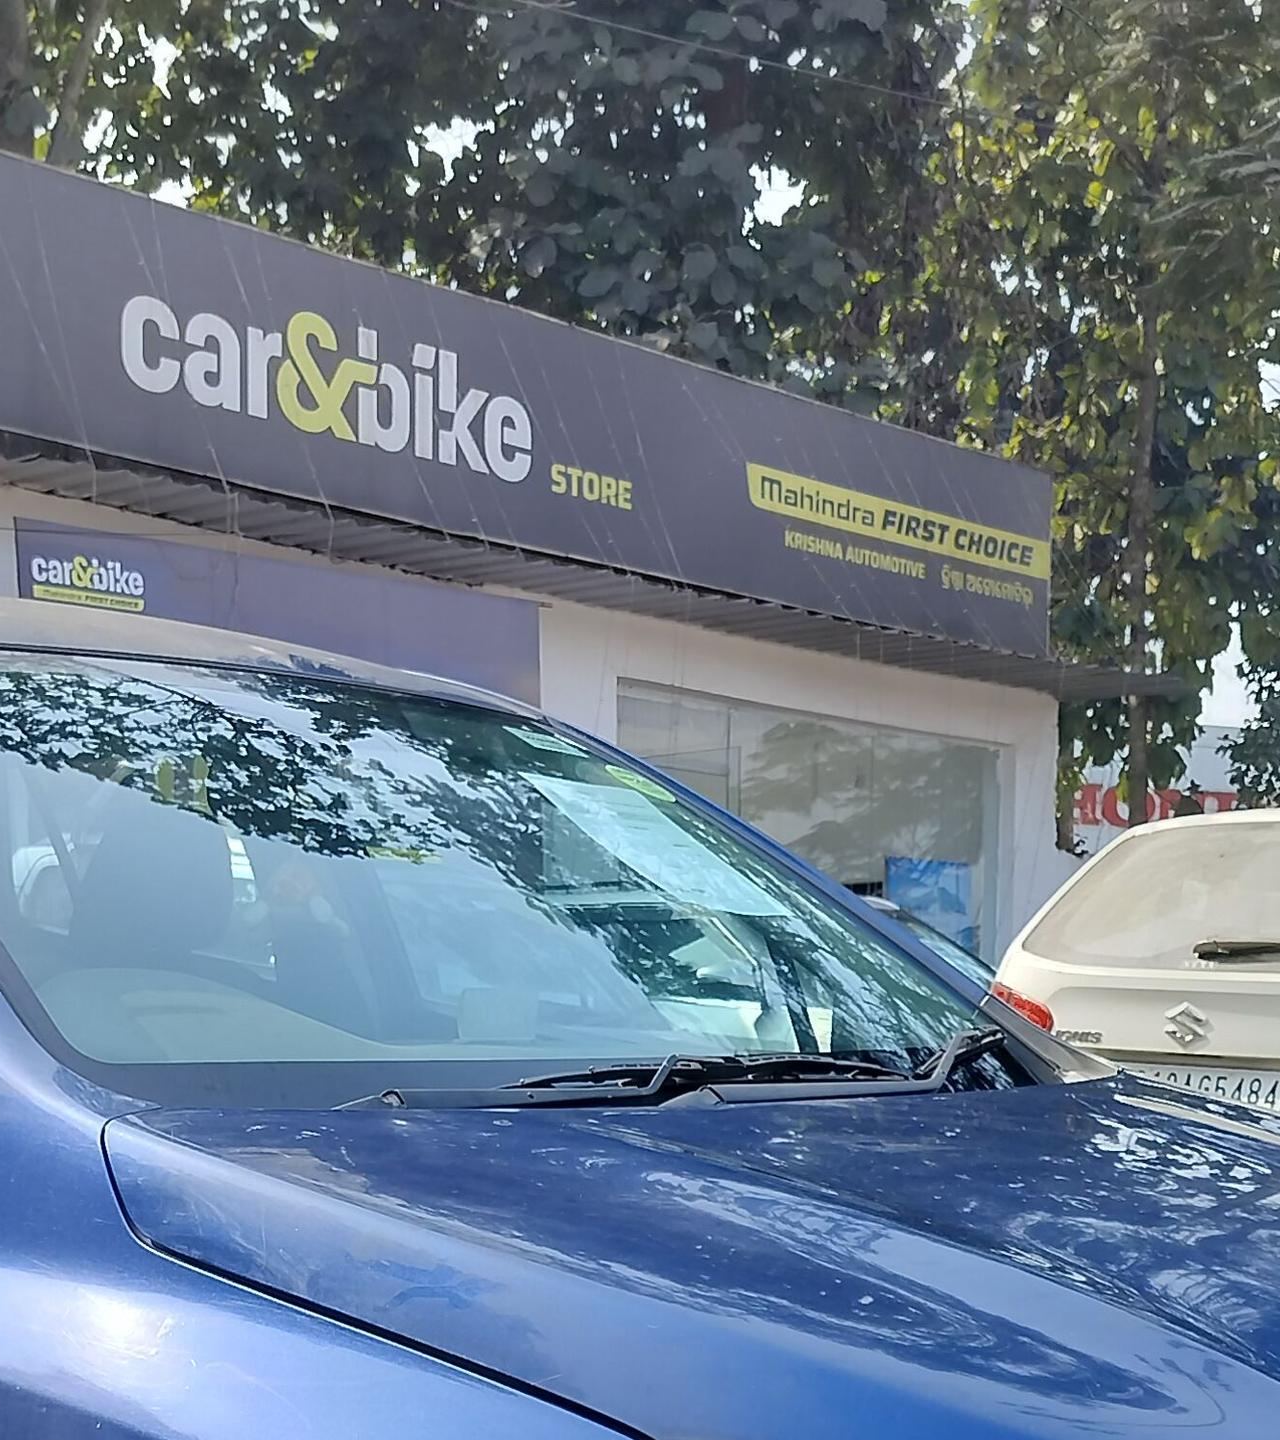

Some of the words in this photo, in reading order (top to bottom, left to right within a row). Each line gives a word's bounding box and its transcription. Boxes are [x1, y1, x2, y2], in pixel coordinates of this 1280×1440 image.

[120, 295, 533, 482] car&bike
[551, 464, 632, 510] STORE
[760, 475, 874, 527] Mahindra
[881, 509, 950, 545] FIRST
[953, 528, 1034, 567] CHOICE
[31, 554, 145, 596] car&bike
[784, 530, 842, 560] KRISHNA
[845, 545, 926, 579] AUTOMOTIVE
